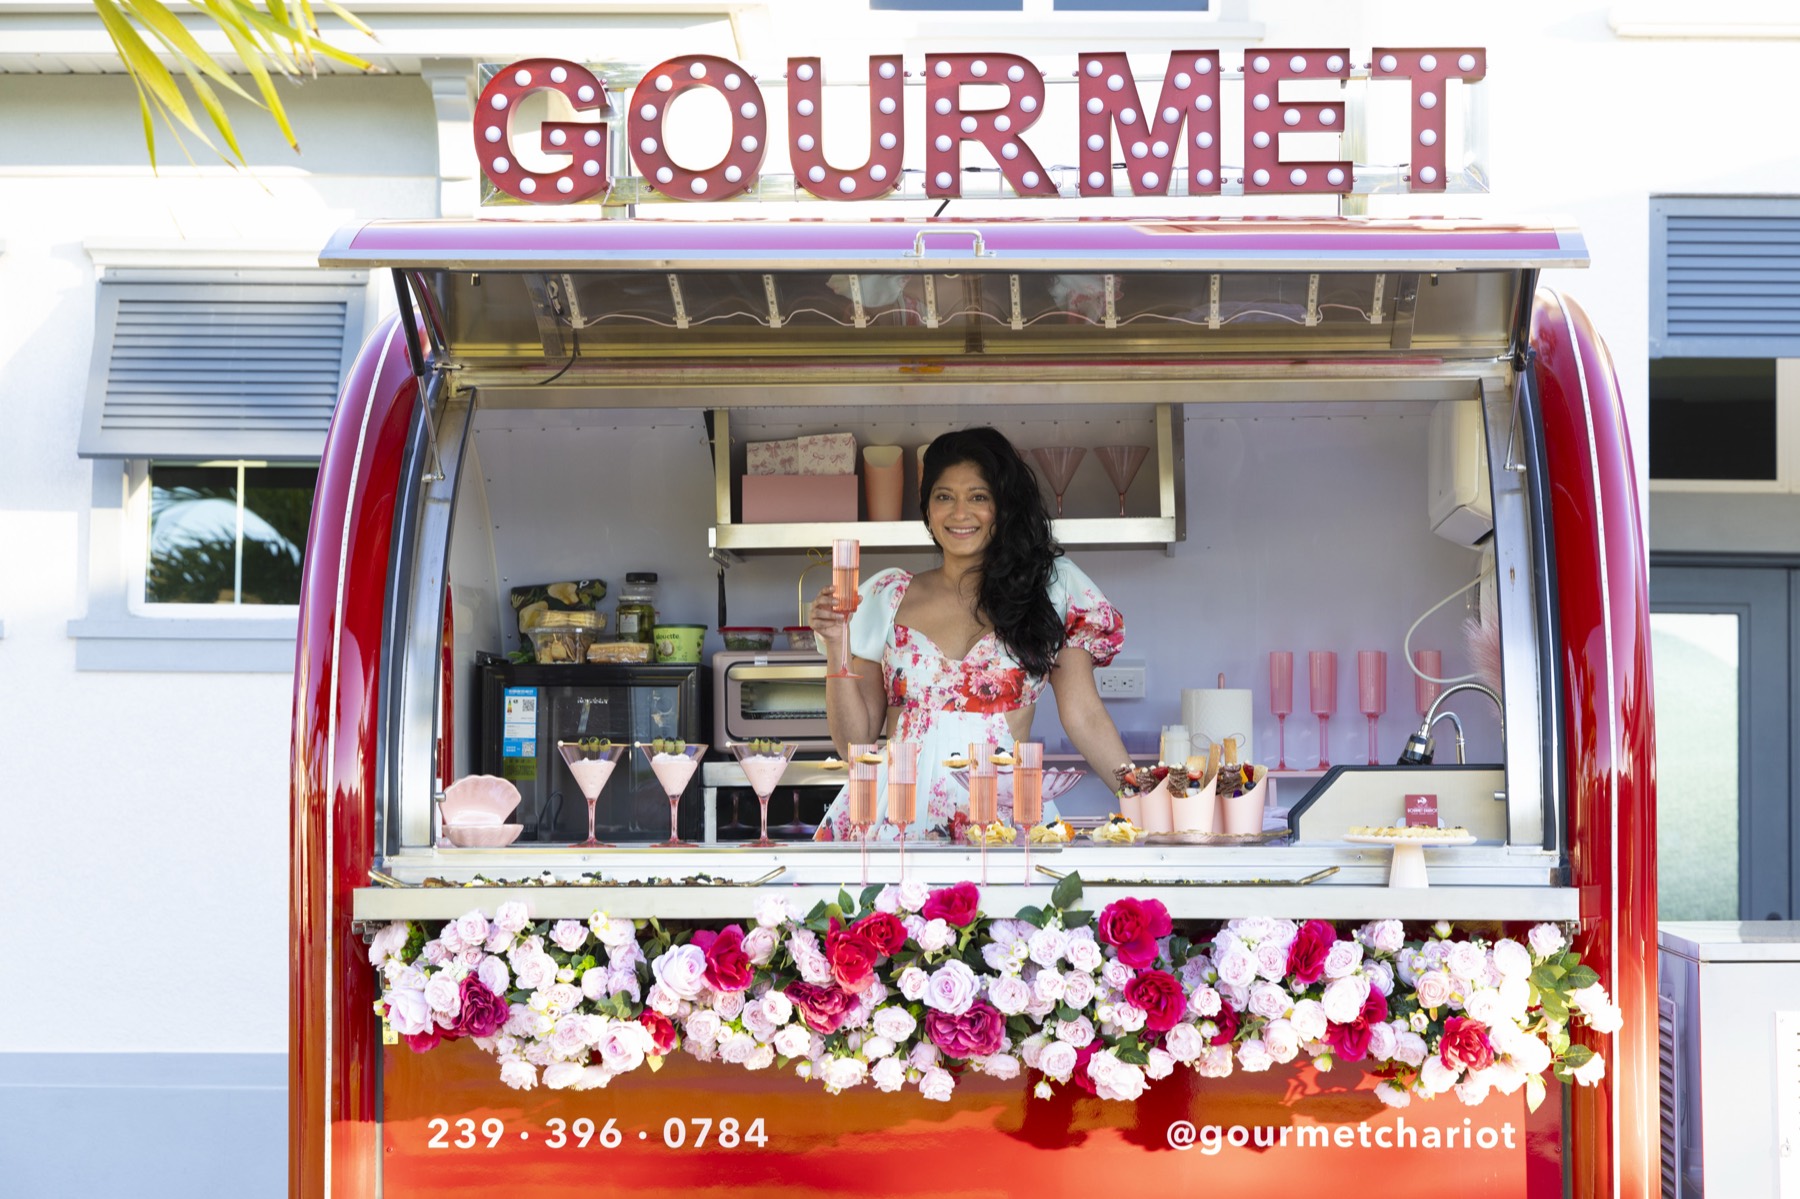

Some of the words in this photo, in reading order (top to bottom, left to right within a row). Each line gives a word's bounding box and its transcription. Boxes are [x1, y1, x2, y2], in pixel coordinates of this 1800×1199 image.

[473, 47, 1487, 205] GOURMET
[427, 1117, 505, 1149] 239
[544, 1117, 623, 1149] 396
[662, 1117, 769, 1149] 0784
[1166, 1117, 1516, 1156] @gourmetchariot
